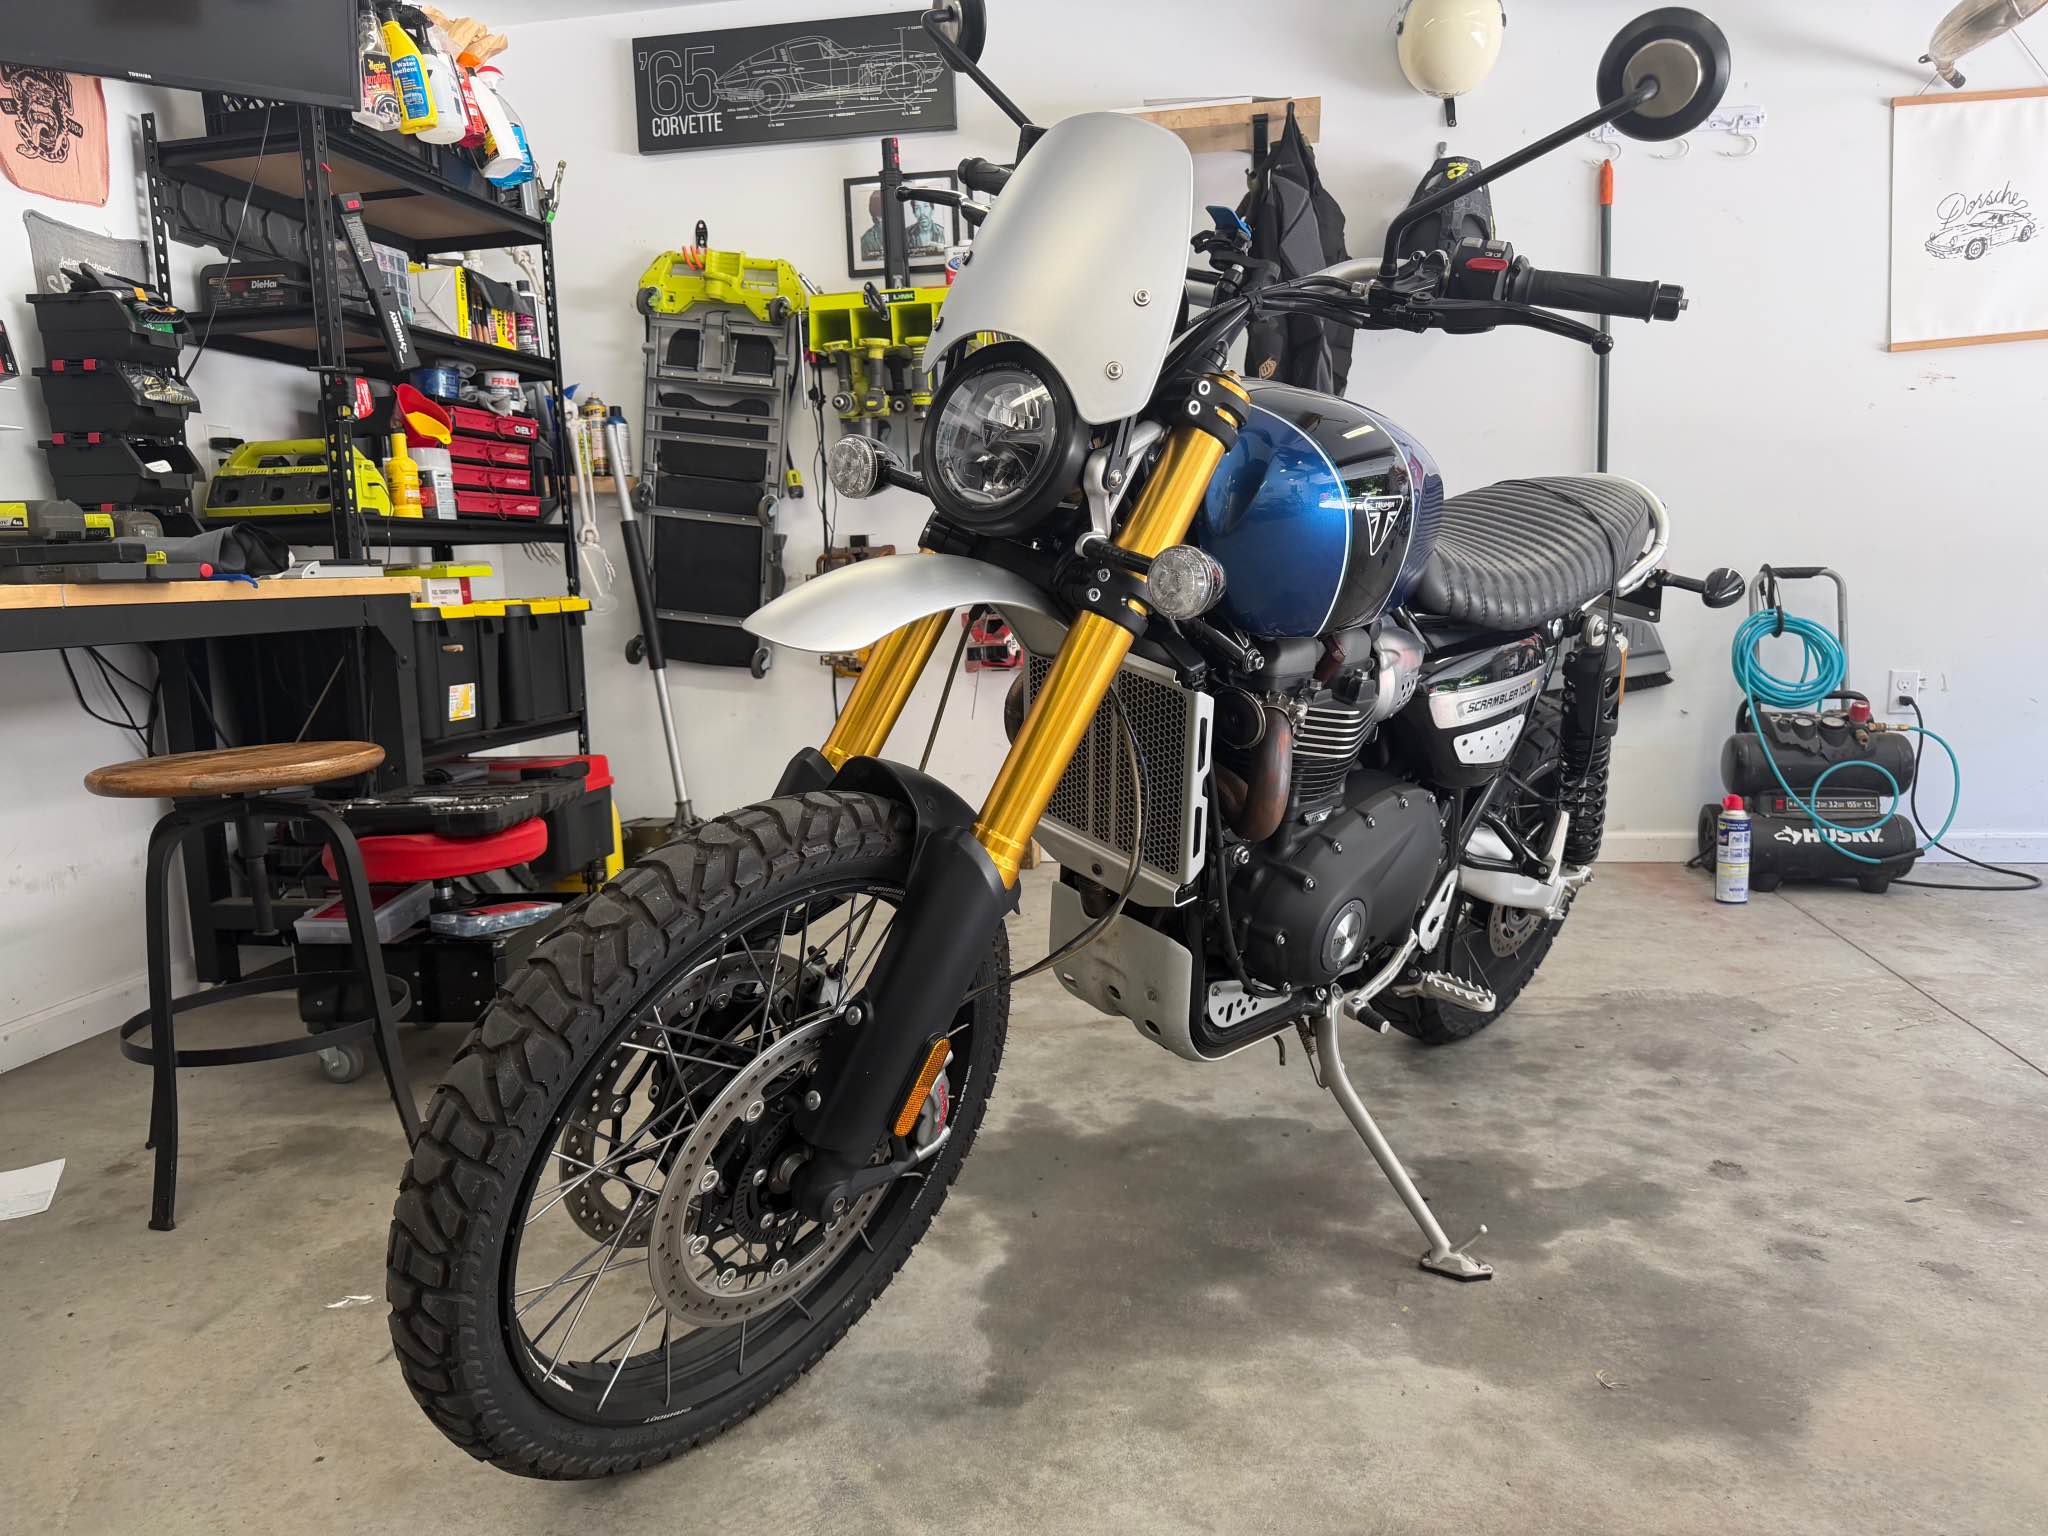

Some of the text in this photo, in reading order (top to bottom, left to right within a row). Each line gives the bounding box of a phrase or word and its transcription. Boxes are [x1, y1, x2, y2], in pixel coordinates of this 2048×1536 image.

[397, 60, 417, 68] Water
[128, 71, 152, 80] TOSHIBA
[393, 67, 418, 76] pellent
[652, 111, 723, 137] CORVETTE
[1937, 180, 2028, 230] Porsche
[251, 279, 277, 289] DieHar
[491, 377, 517, 387] FRAM
[1466, 688, 1519, 714] SCRAMBLER
[1802, 828, 1882, 843] HUSKY
